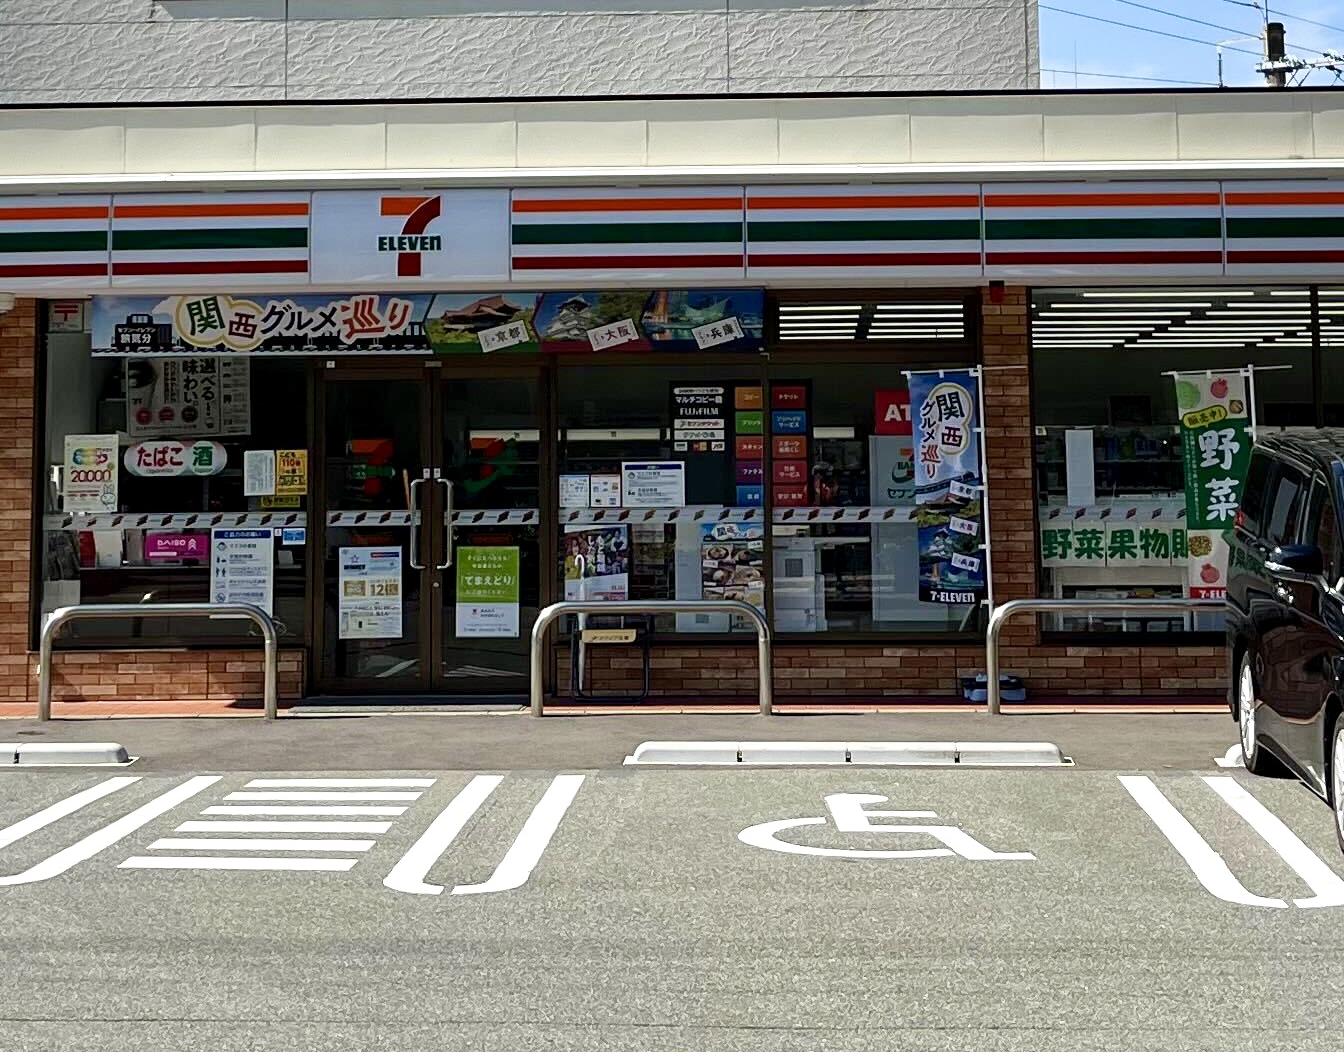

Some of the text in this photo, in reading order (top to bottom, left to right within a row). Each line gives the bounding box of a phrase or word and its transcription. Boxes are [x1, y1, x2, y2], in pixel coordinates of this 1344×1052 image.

[186, 295, 410, 339] 関西グルメ巡り
[137, 445, 184, 467] たばこ
[192, 446, 213, 466] 酒
[1199, 428, 1240, 521] 野菜
